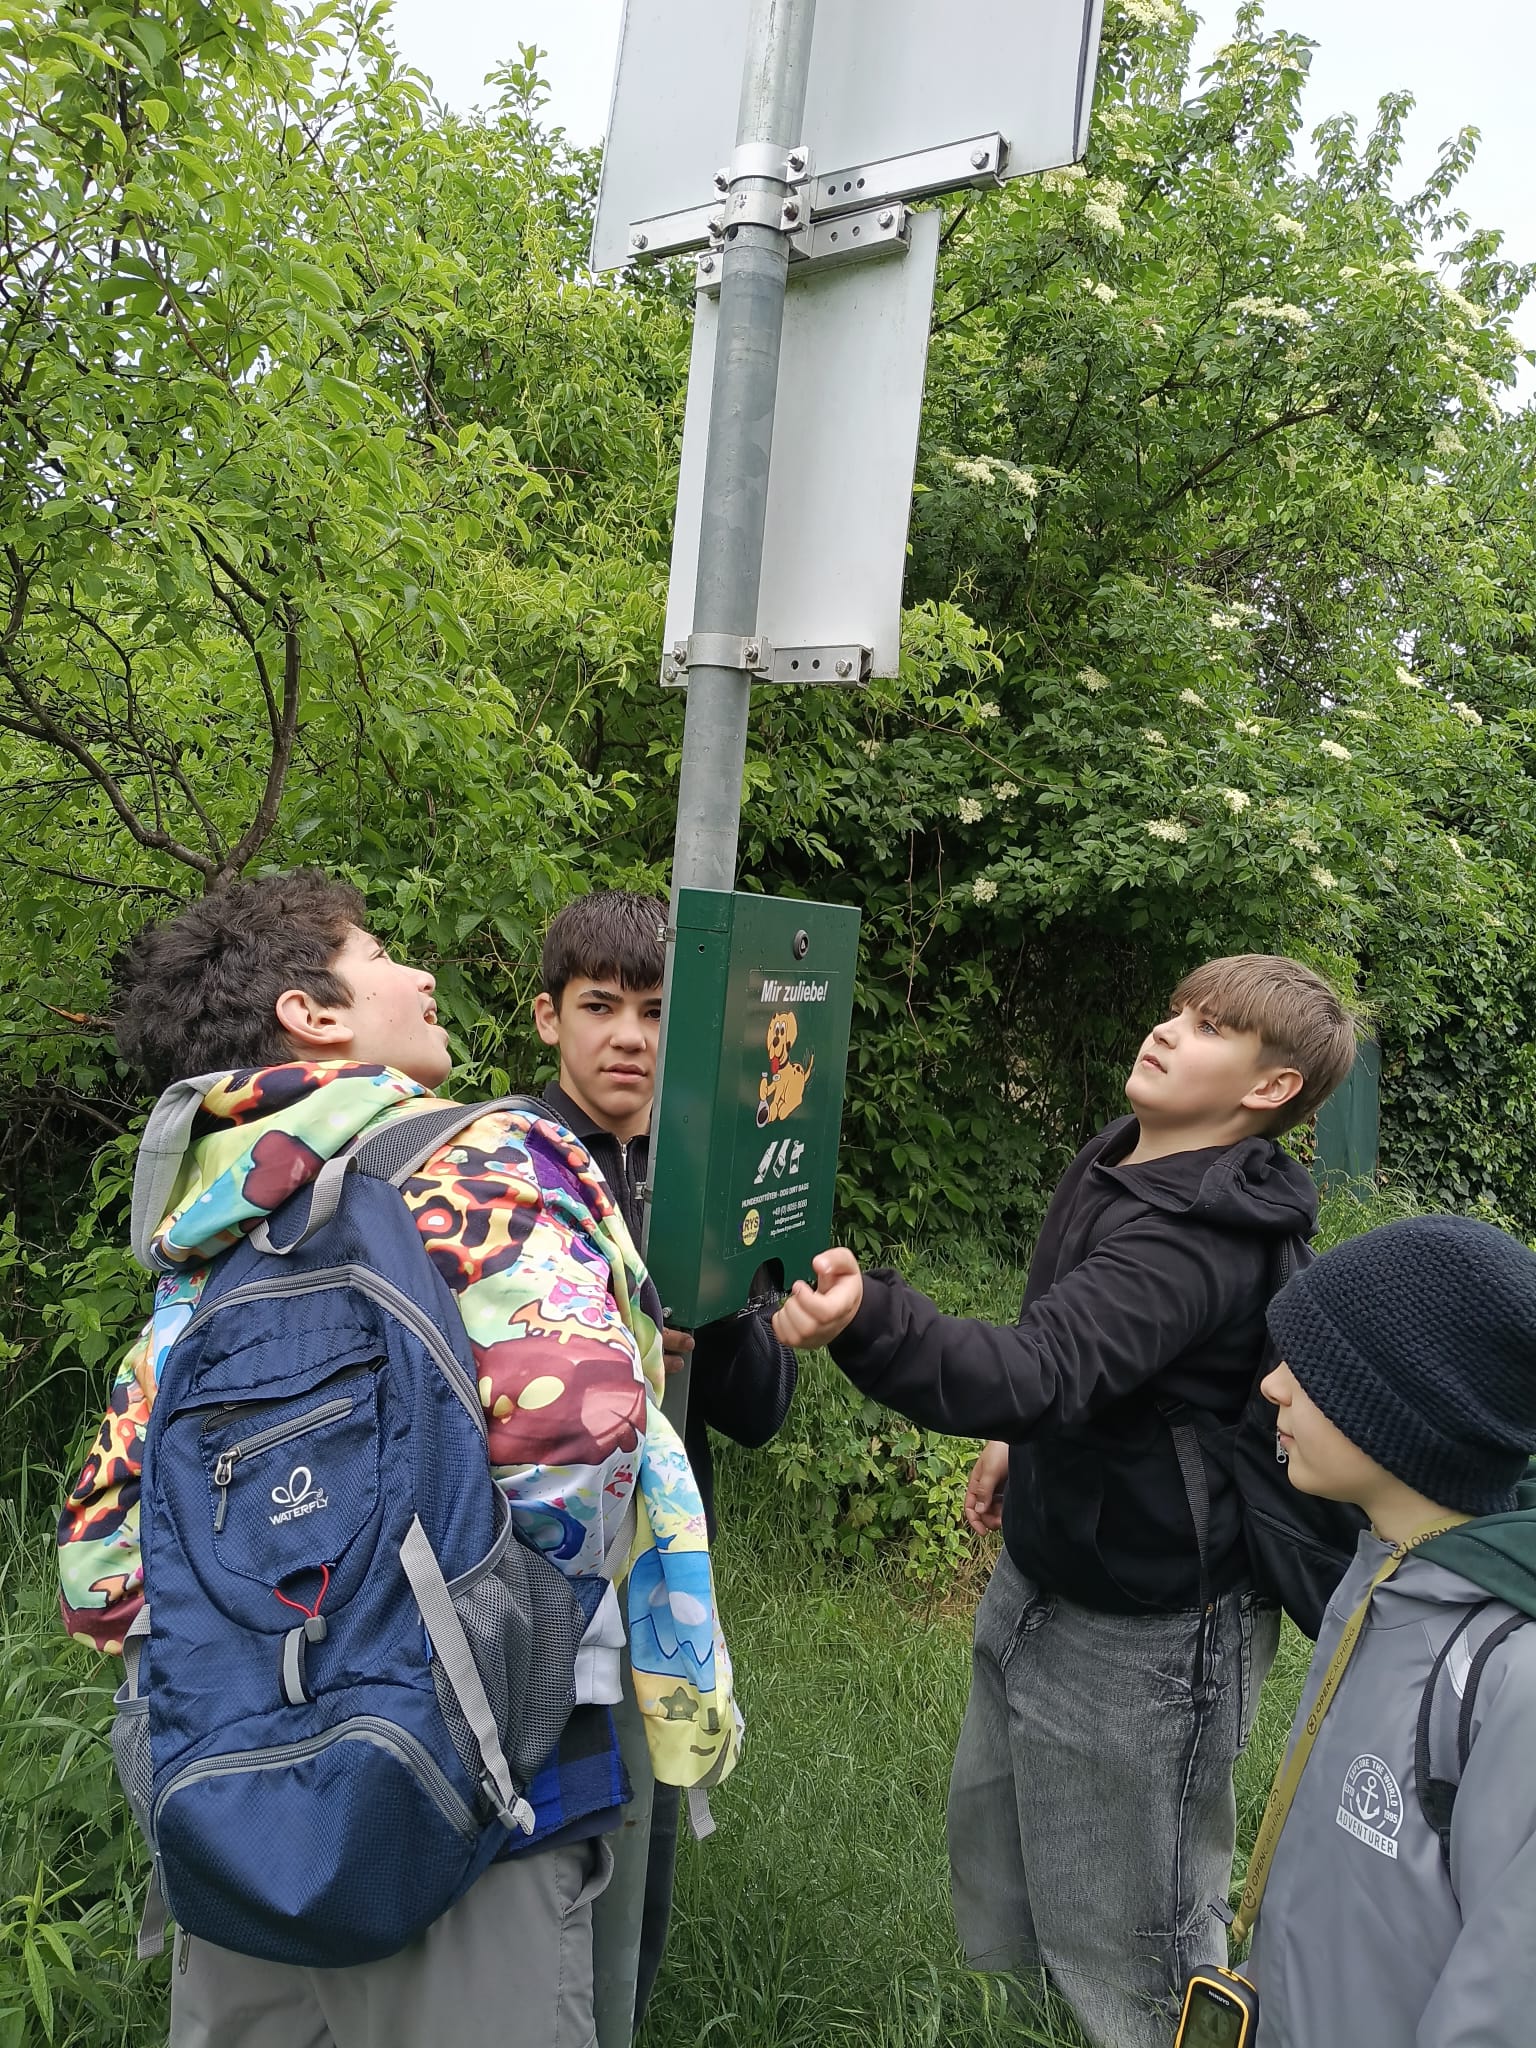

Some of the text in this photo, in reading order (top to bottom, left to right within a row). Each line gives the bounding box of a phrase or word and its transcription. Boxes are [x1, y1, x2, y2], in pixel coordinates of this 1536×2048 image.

[761, 980, 829, 1002] Mir zuliebe!
[744, 1216, 759, 1231] RYS
[269, 1496, 329, 1525] WATERFLY
[1316, 1626, 1355, 1713] OPENCACHING
[1349, 1758, 1398, 1807] EXPLORE THE WORLD
[1384, 1809, 1399, 1824] 1995
[1338, 1809, 1394, 1855] ADVENTURER
